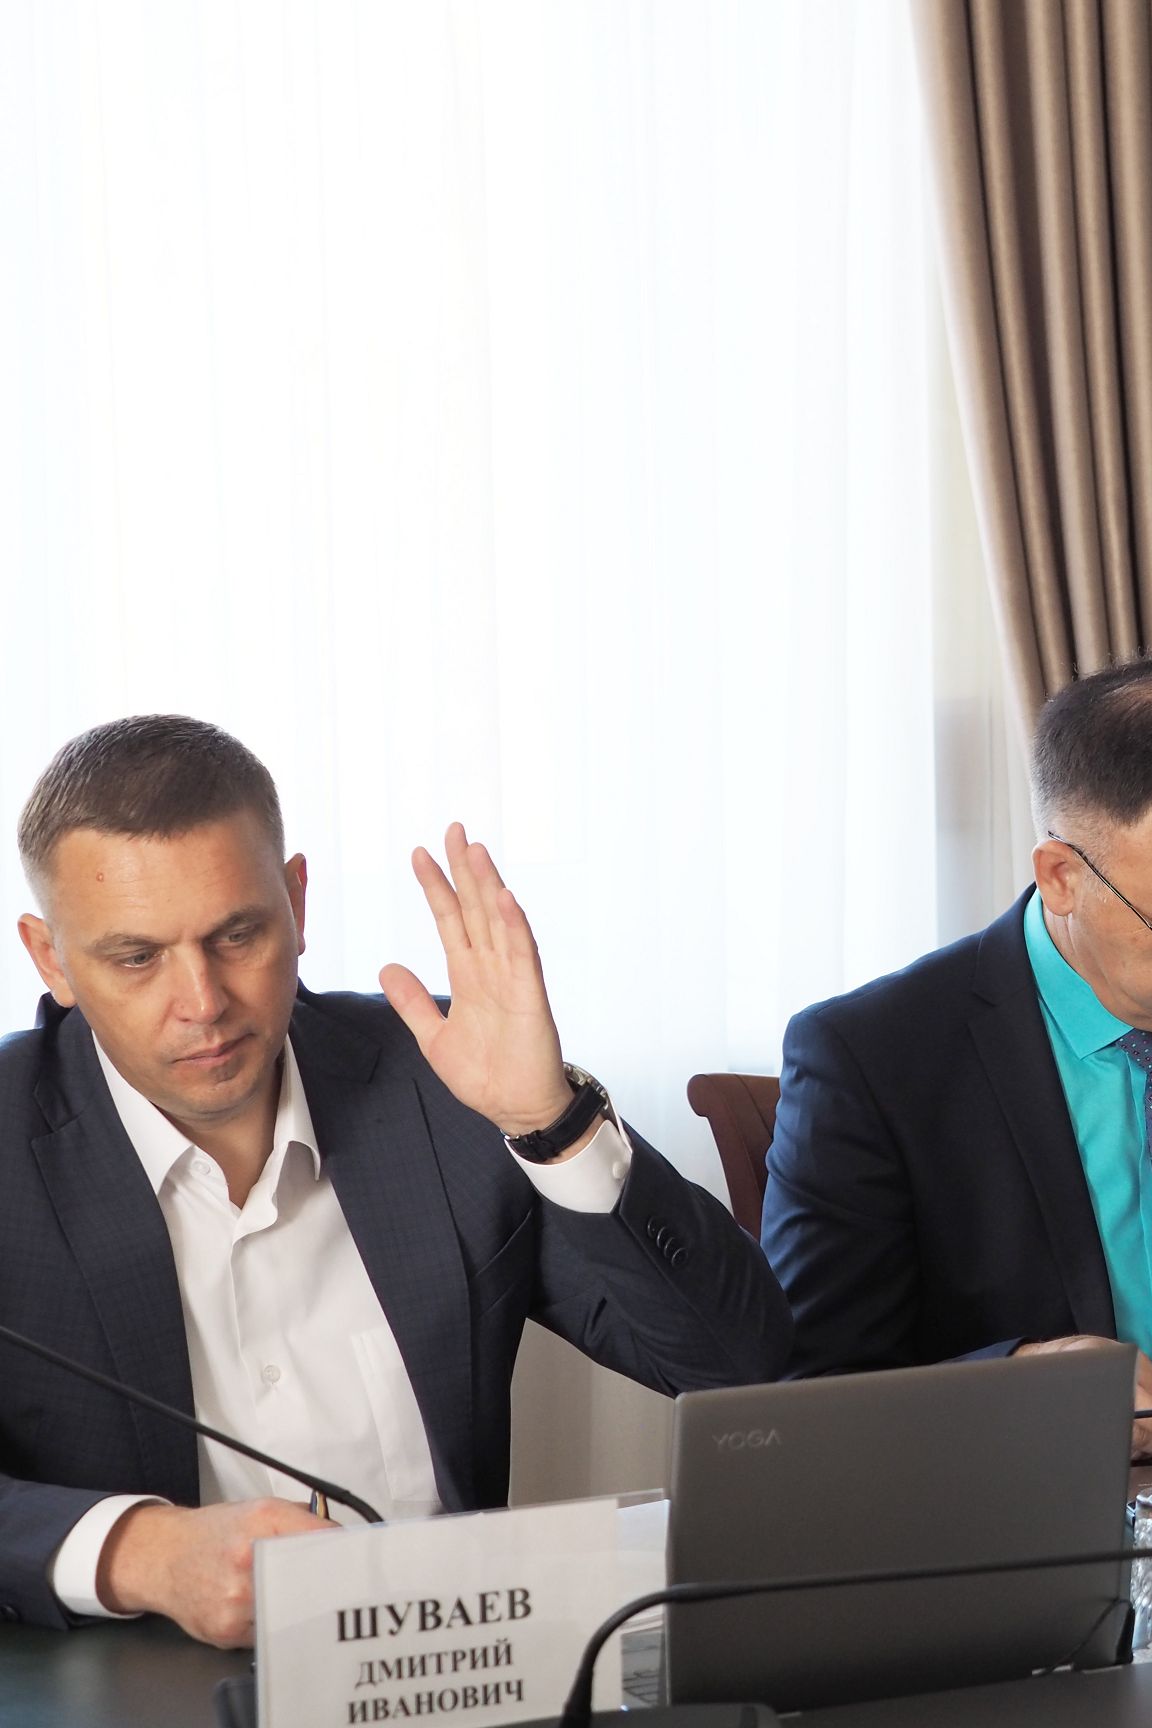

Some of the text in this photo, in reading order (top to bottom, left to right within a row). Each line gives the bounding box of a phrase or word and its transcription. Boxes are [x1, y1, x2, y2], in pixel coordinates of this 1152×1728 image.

[711, 1428, 782, 1451] YOGA
[335, 1586, 533, 1643] ШУВАЕВ
[354, 1638, 515, 1689] ДМИТРИЙ
[346, 1679, 525, 1726] ИВАНОВИЧ
